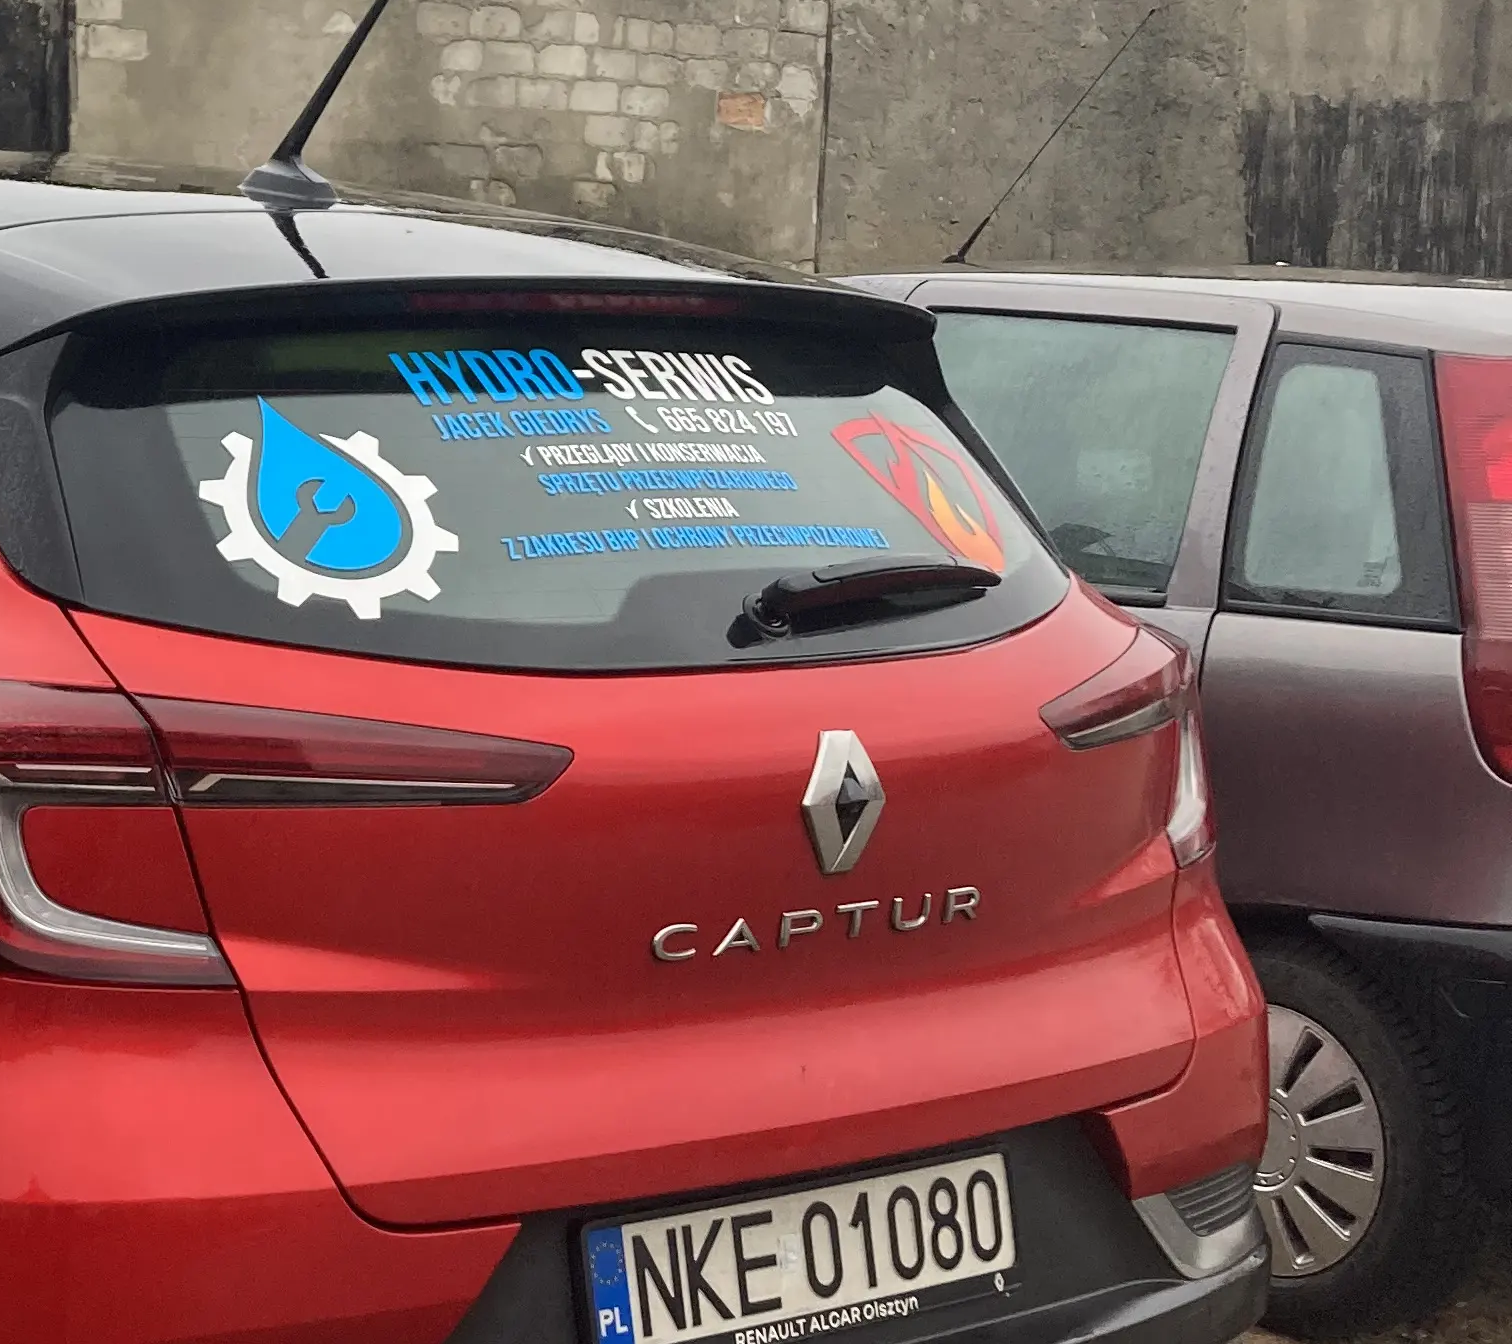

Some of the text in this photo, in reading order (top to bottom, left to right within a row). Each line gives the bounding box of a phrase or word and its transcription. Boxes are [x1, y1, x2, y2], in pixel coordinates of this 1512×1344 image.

[388, 348, 776, 407] HYDRO-SERWIS
[431, 406, 799, 441] JACEK GIEDRYS 665 824 197
[536, 442, 767, 467] PRZEGLĄDY I KONSERWACJA
[538, 467, 799, 496] SPRZĘTU PRZECIWPOŻAROWEGO
[643, 497, 740, 519] SZKOLENIA
[500, 522, 890, 561] Z ZAKRESU BHP I OCHRONY PRZECIWPOŻAROWEJ
[652, 886, 981, 962] CAPTUR
[631, 1169, 1004, 1338] NKE 01080
[598, 1308, 630, 1338] PL
[809, 1306, 862, 1334] ALCAR
[863, 1295, 920, 1321] Olsztyn
